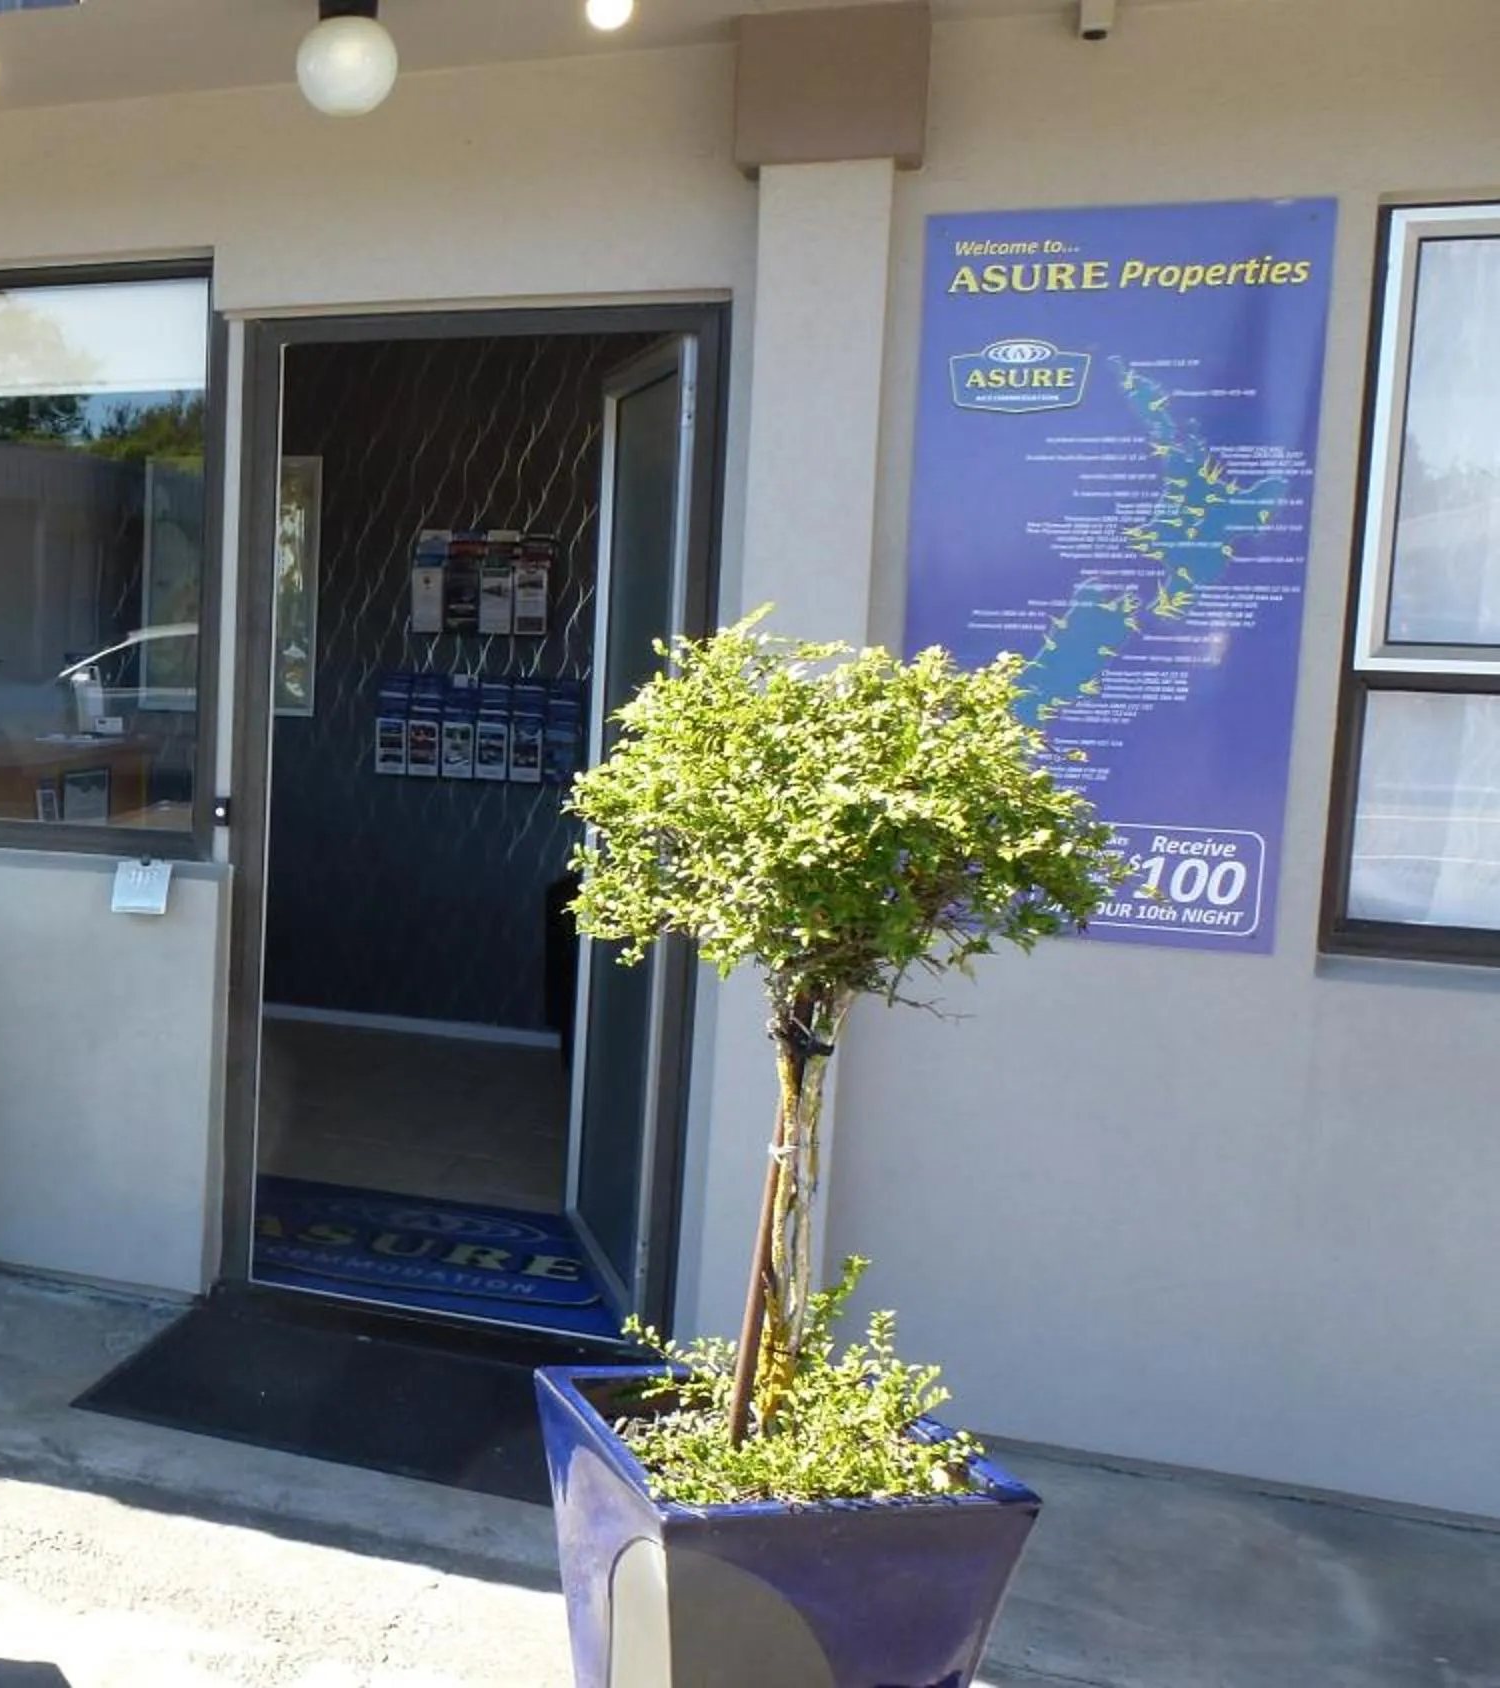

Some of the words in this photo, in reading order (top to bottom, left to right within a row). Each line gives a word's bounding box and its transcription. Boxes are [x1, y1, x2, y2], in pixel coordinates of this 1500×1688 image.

[955, 240, 1039, 256] Welcome
[948, 261, 1109, 293] ASURE
[1119, 256, 1311, 293] Properties
[965, 367, 1076, 388] ASURE
[1151, 836, 1237, 858] Receive
[1129, 853, 1247, 906] $100
[1095, 901, 1133, 919] OUR
[1136, 904, 1177, 920] 10th
[1181, 907, 1245, 927] NIGHT
[266, 1246, 536, 1295] COMMODATION
